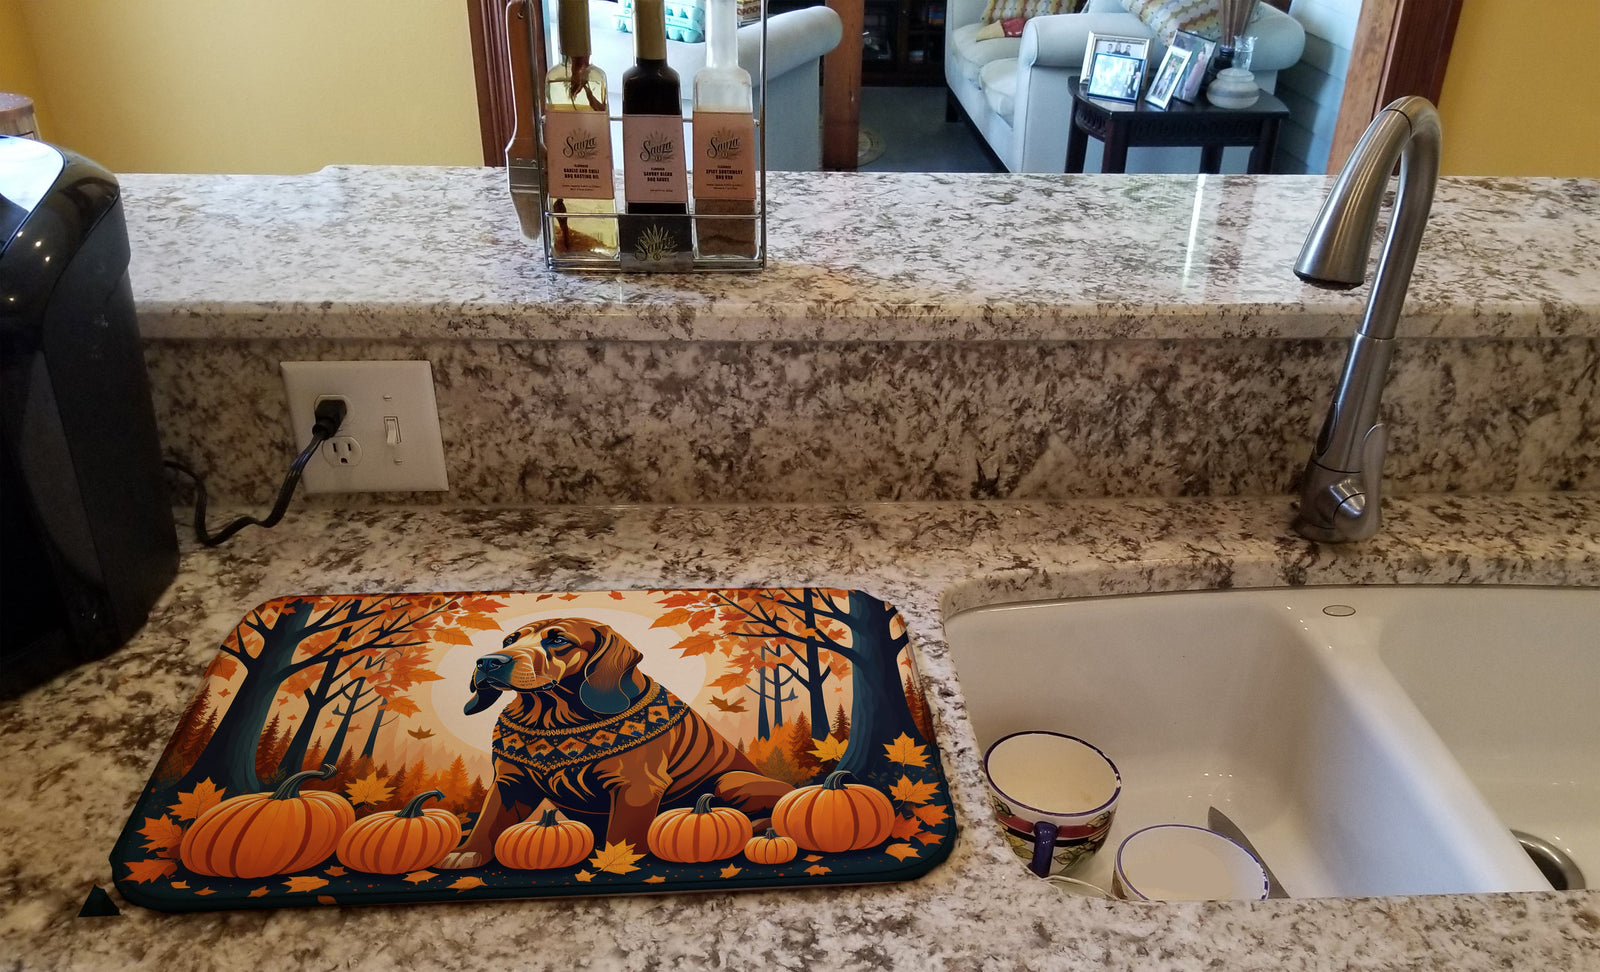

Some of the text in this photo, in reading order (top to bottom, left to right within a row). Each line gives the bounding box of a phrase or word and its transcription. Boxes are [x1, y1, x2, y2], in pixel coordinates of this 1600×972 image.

[563, 136, 598, 158] Sauza
[640, 140, 674, 162] Sauza
[706, 136, 741, 158] Sauza
[634, 236, 678, 262] Sauza
